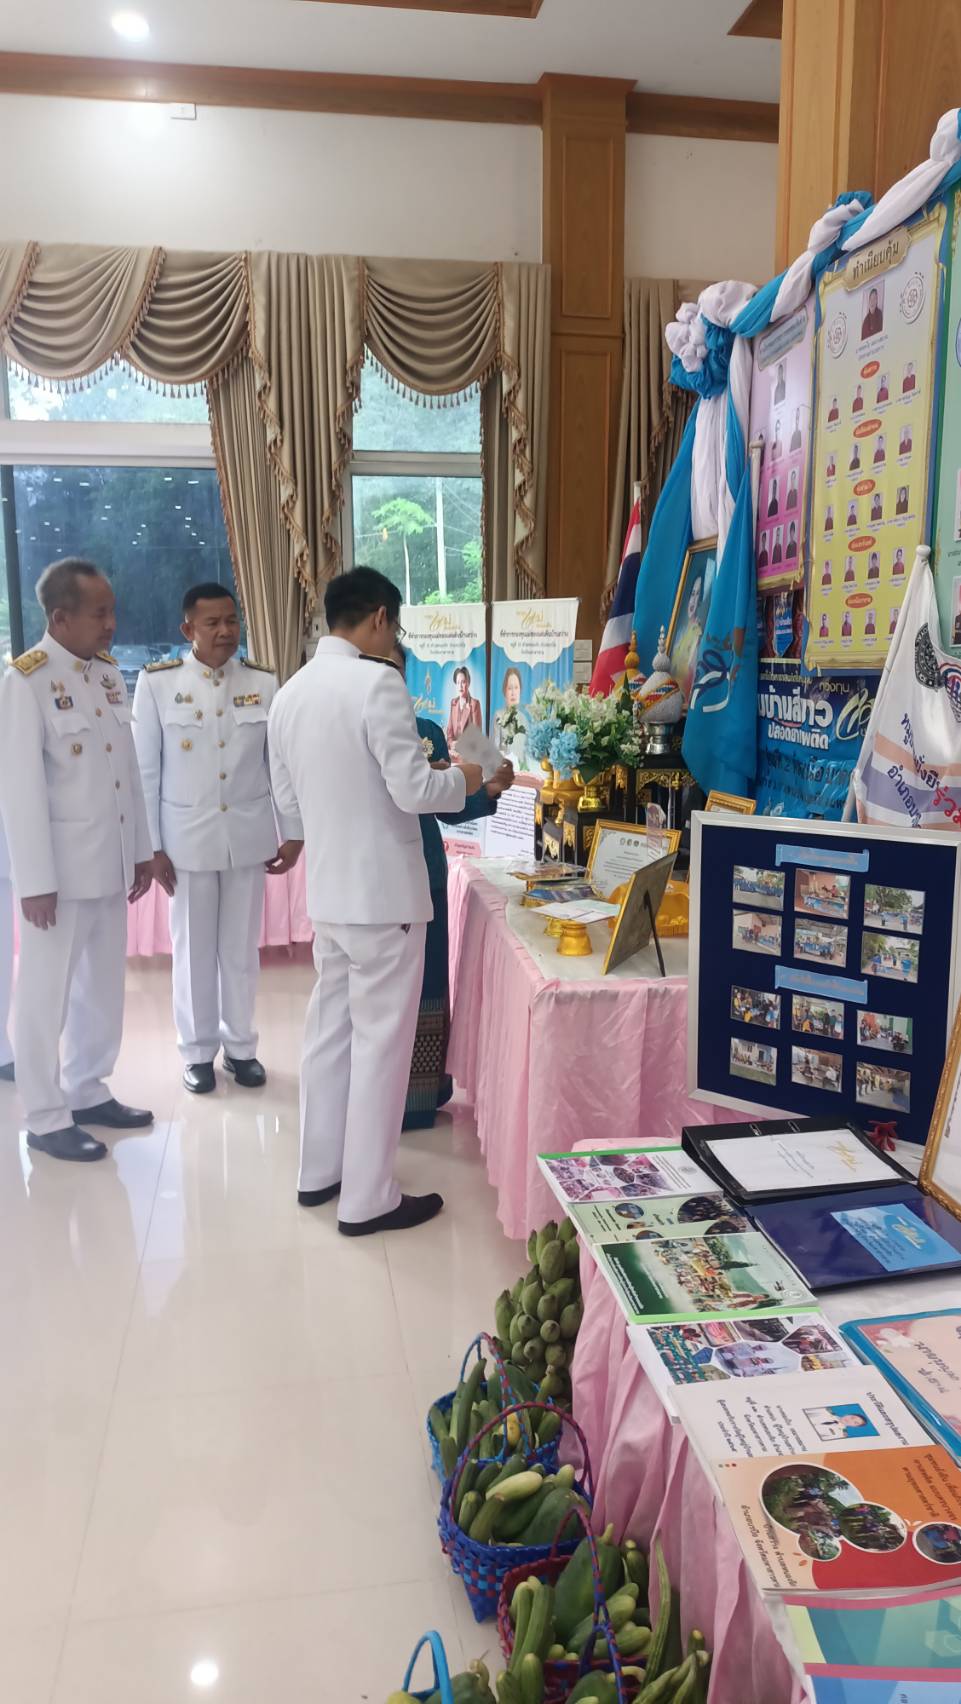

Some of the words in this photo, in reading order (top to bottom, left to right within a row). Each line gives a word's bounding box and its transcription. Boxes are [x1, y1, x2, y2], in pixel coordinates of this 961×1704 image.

[853, 240, 899, 280] ทำเนียบคุ้ม
